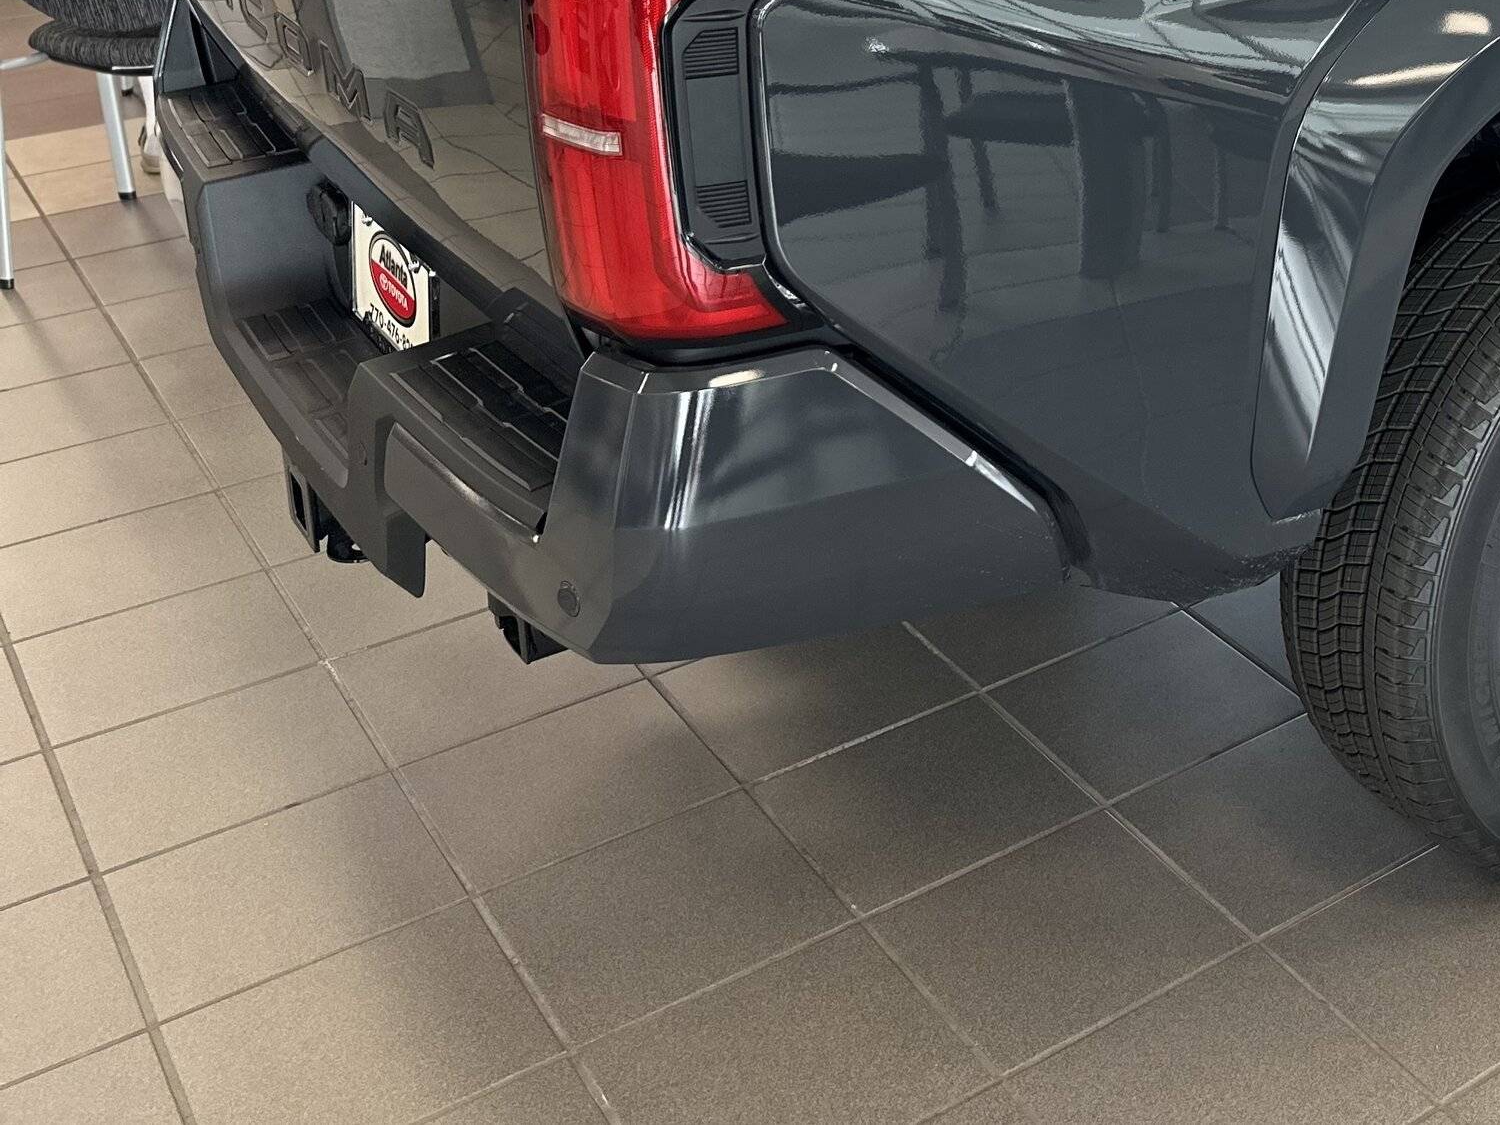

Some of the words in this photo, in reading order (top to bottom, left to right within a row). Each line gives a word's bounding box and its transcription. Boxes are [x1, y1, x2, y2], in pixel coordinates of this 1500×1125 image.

[378, 244, 408, 290] Atlanta
[387, 279, 409, 311] TOYOTA
[369, 302, 414, 350] 770-476-8
